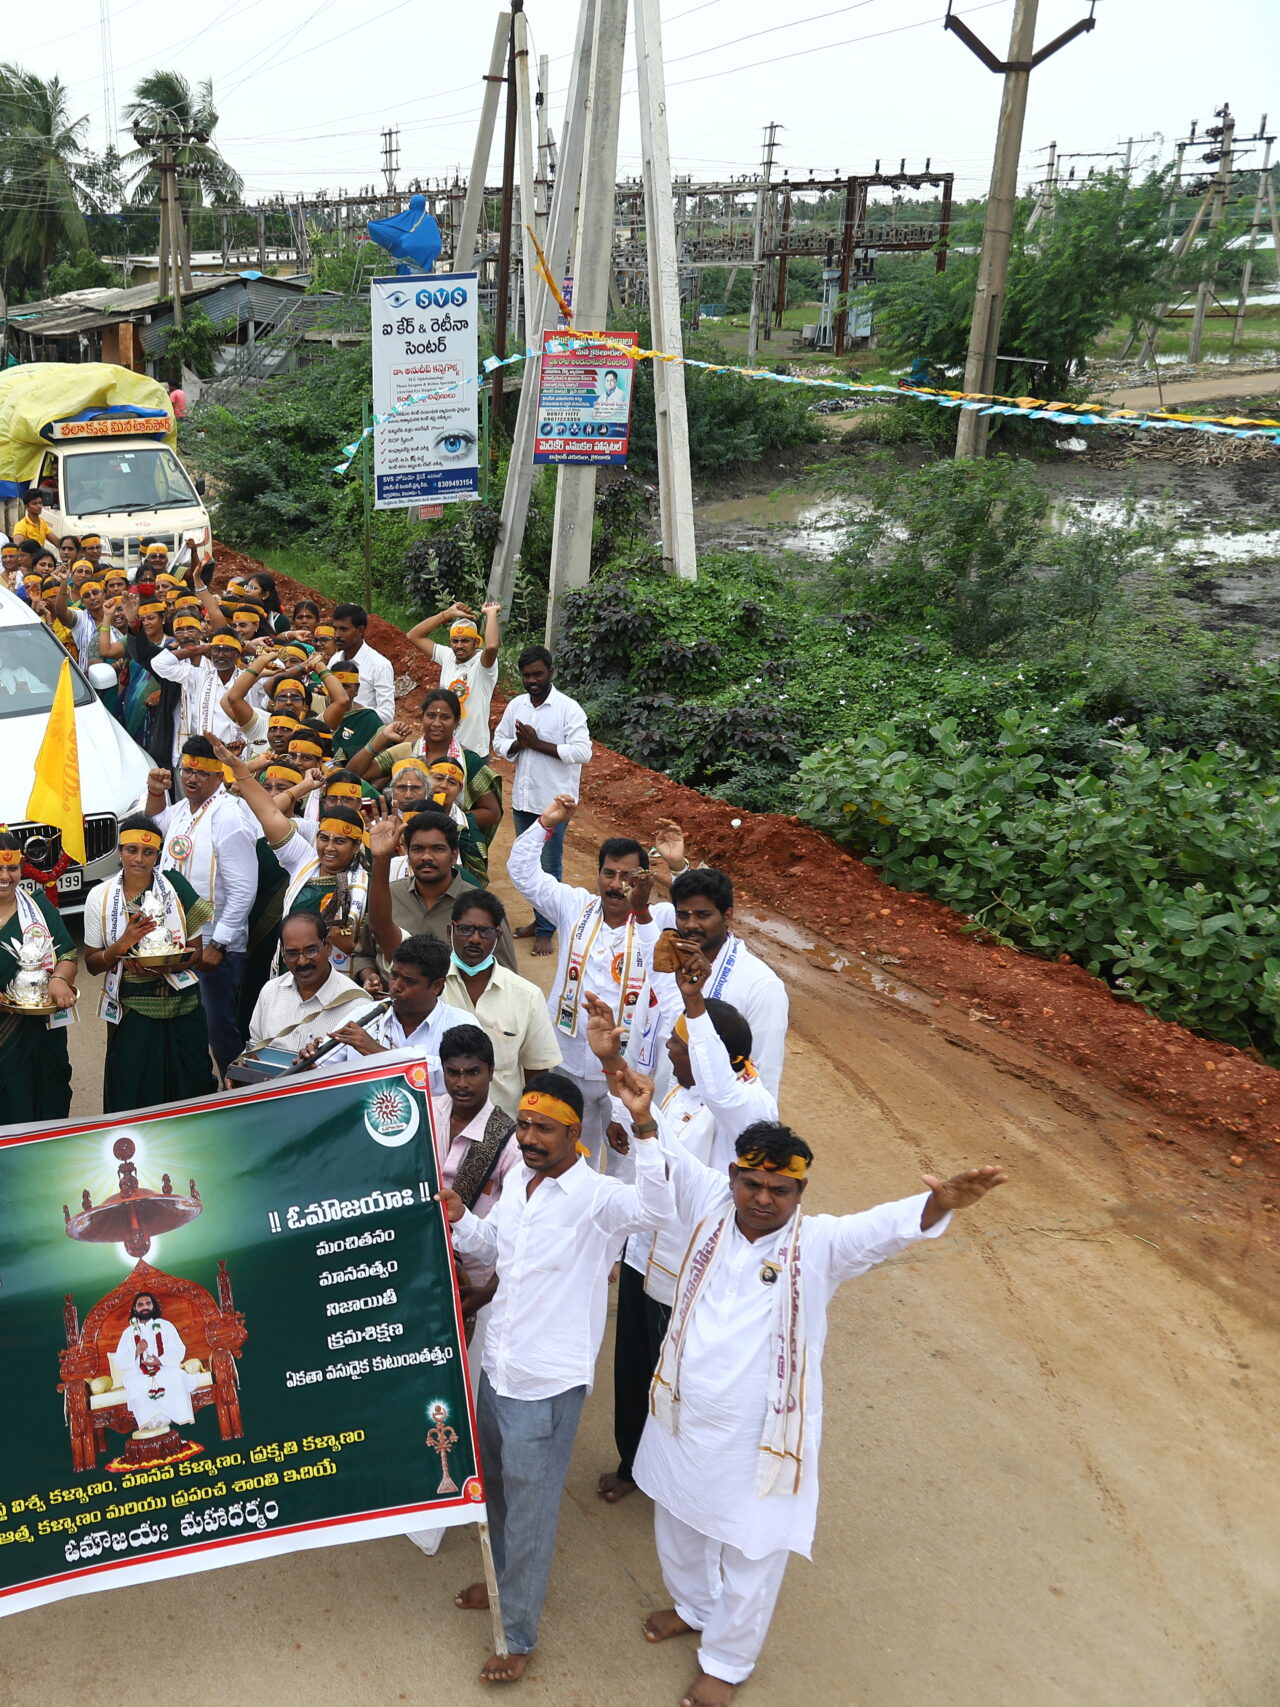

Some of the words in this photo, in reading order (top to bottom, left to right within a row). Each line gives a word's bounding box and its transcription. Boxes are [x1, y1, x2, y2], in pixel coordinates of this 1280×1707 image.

[417, 288, 466, 308] SVS
[396, 317, 415, 334] కేర్
[418, 324, 427, 334] &
[430, 313, 469, 332] రెటీనా
[405, 336, 447, 355] సెంటర్
[58, 875, 80, 889] 199
[286, 1188, 415, 1230] ఓమౌజయాః
[316, 1229, 395, 1256] మంచితనం
[318, 1259, 398, 1287] మానవత్వం
[326, 1288, 398, 1317] నిజాయితీ
[327, 1322, 404, 1350] క్రమశిక్షణ
[286, 1368, 323, 1388] ఏకతా
[11, 1494, 45, 1518] విశ్వ
[121, 1465, 175, 1489] మానవ
[249, 1437, 299, 1464] ప్రకృతి
[301, 1426, 367, 1456] కళ్యాణం
[36, 1508, 102, 1538] కళ్యాణం
[104, 1494, 168, 1520] మరియు
[170, 1482, 228, 1508] ప్రపంచ
[230, 1471, 281, 1494] శాంతి
[283, 1457, 338, 1484] ఇదియే
